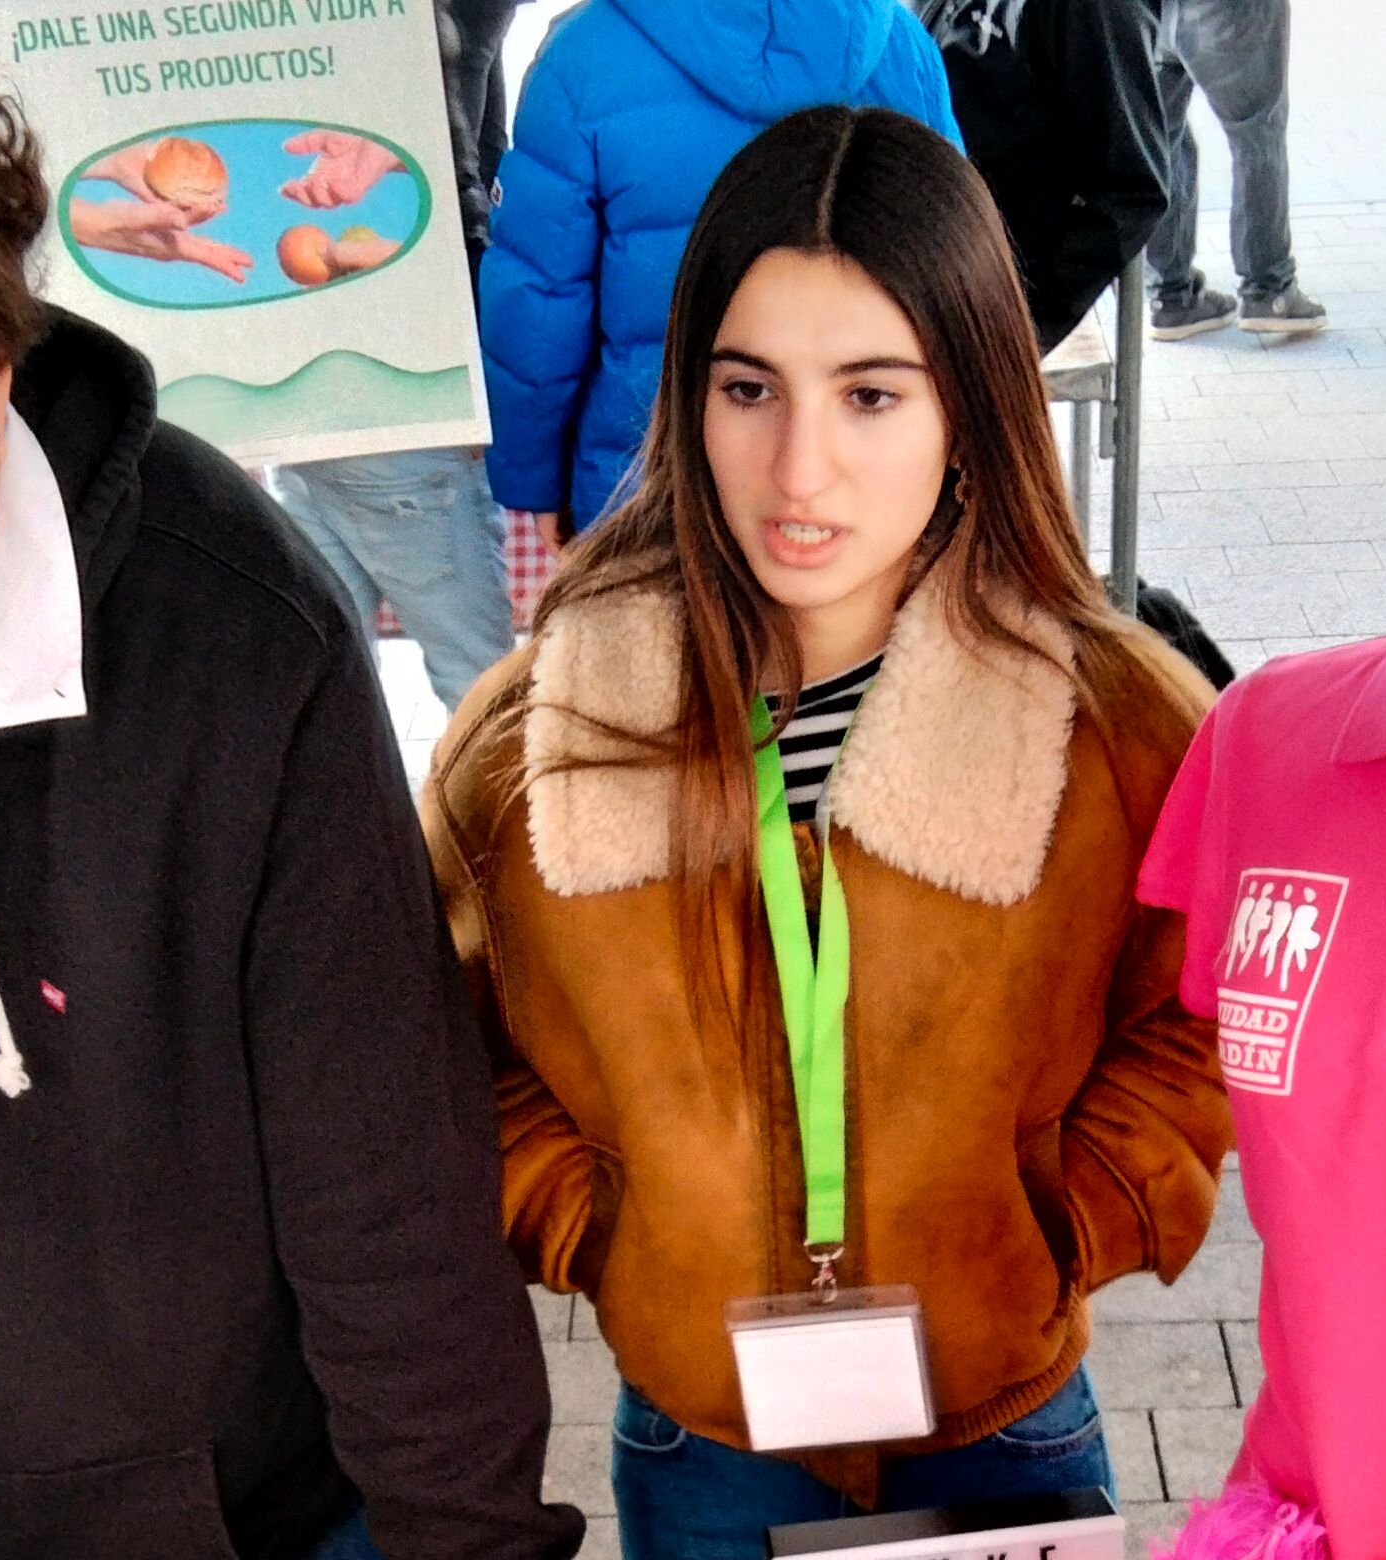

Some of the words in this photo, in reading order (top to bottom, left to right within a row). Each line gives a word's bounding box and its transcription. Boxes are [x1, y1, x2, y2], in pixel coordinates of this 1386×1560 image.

[12, 15, 91, 63] ¡DALE
[97, 9, 156, 43] UNA
[164, 0, 296, 37] SEGUNDA
[308, 0, 376, 24] VIDA
[96, 63, 151, 96] TUS
[160, 46, 335, 91] PRODUCTOS!
[1218, 1002, 1289, 1034] UDAD
